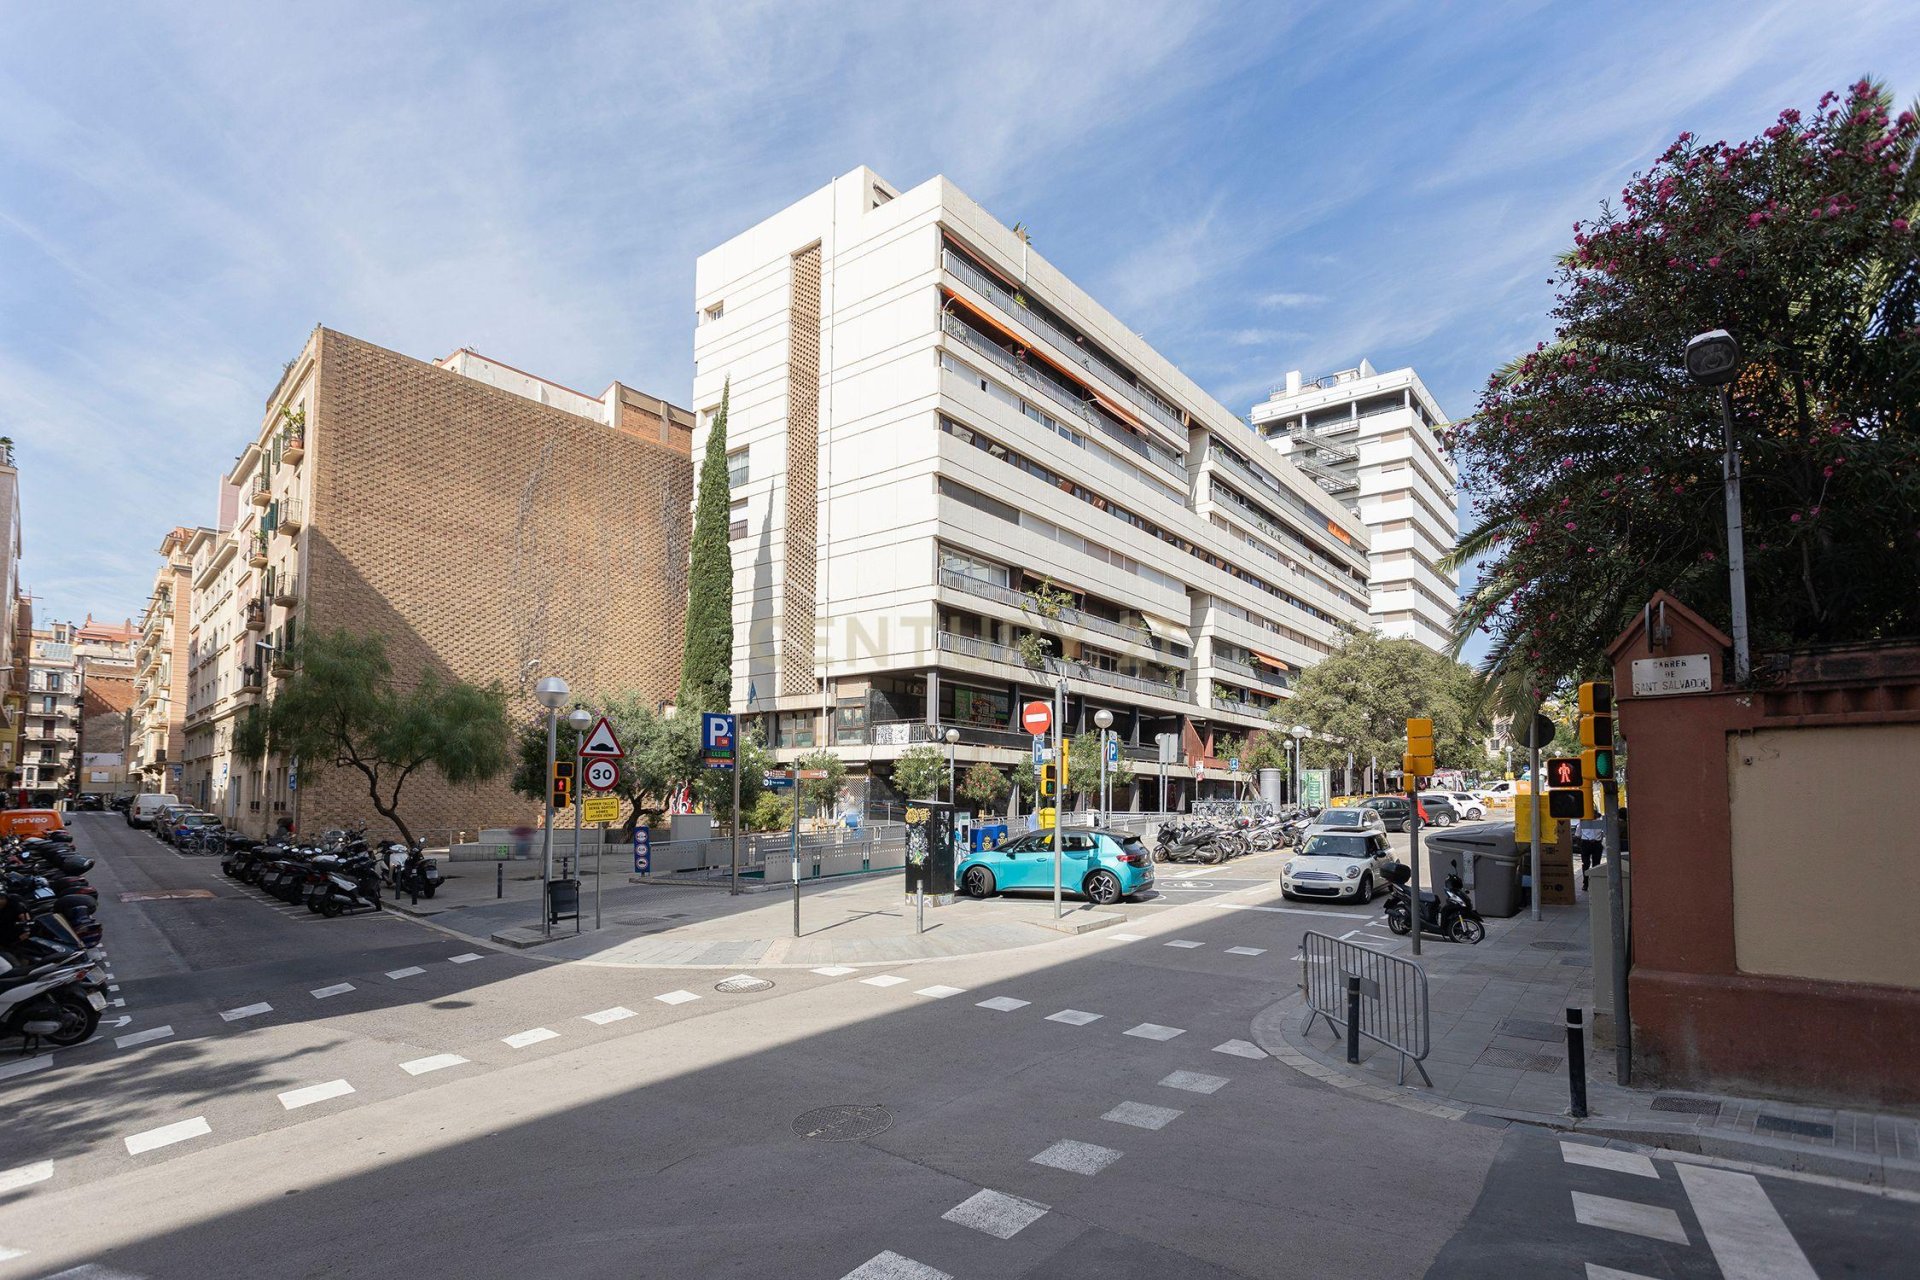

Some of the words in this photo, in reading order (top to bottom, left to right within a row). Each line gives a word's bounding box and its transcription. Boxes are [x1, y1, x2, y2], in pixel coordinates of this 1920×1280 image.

[1653, 660, 1687, 669] CARRER
[1665, 670, 1676, 678] DE
[1634, 681, 1658, 692] SANT
[710, 717, 729, 746] P
[1035, 743, 1043, 762] P
[1110, 746, 1117, 760] P
[592, 768, 612, 780] 30
[11, 817, 48, 825] serveo
